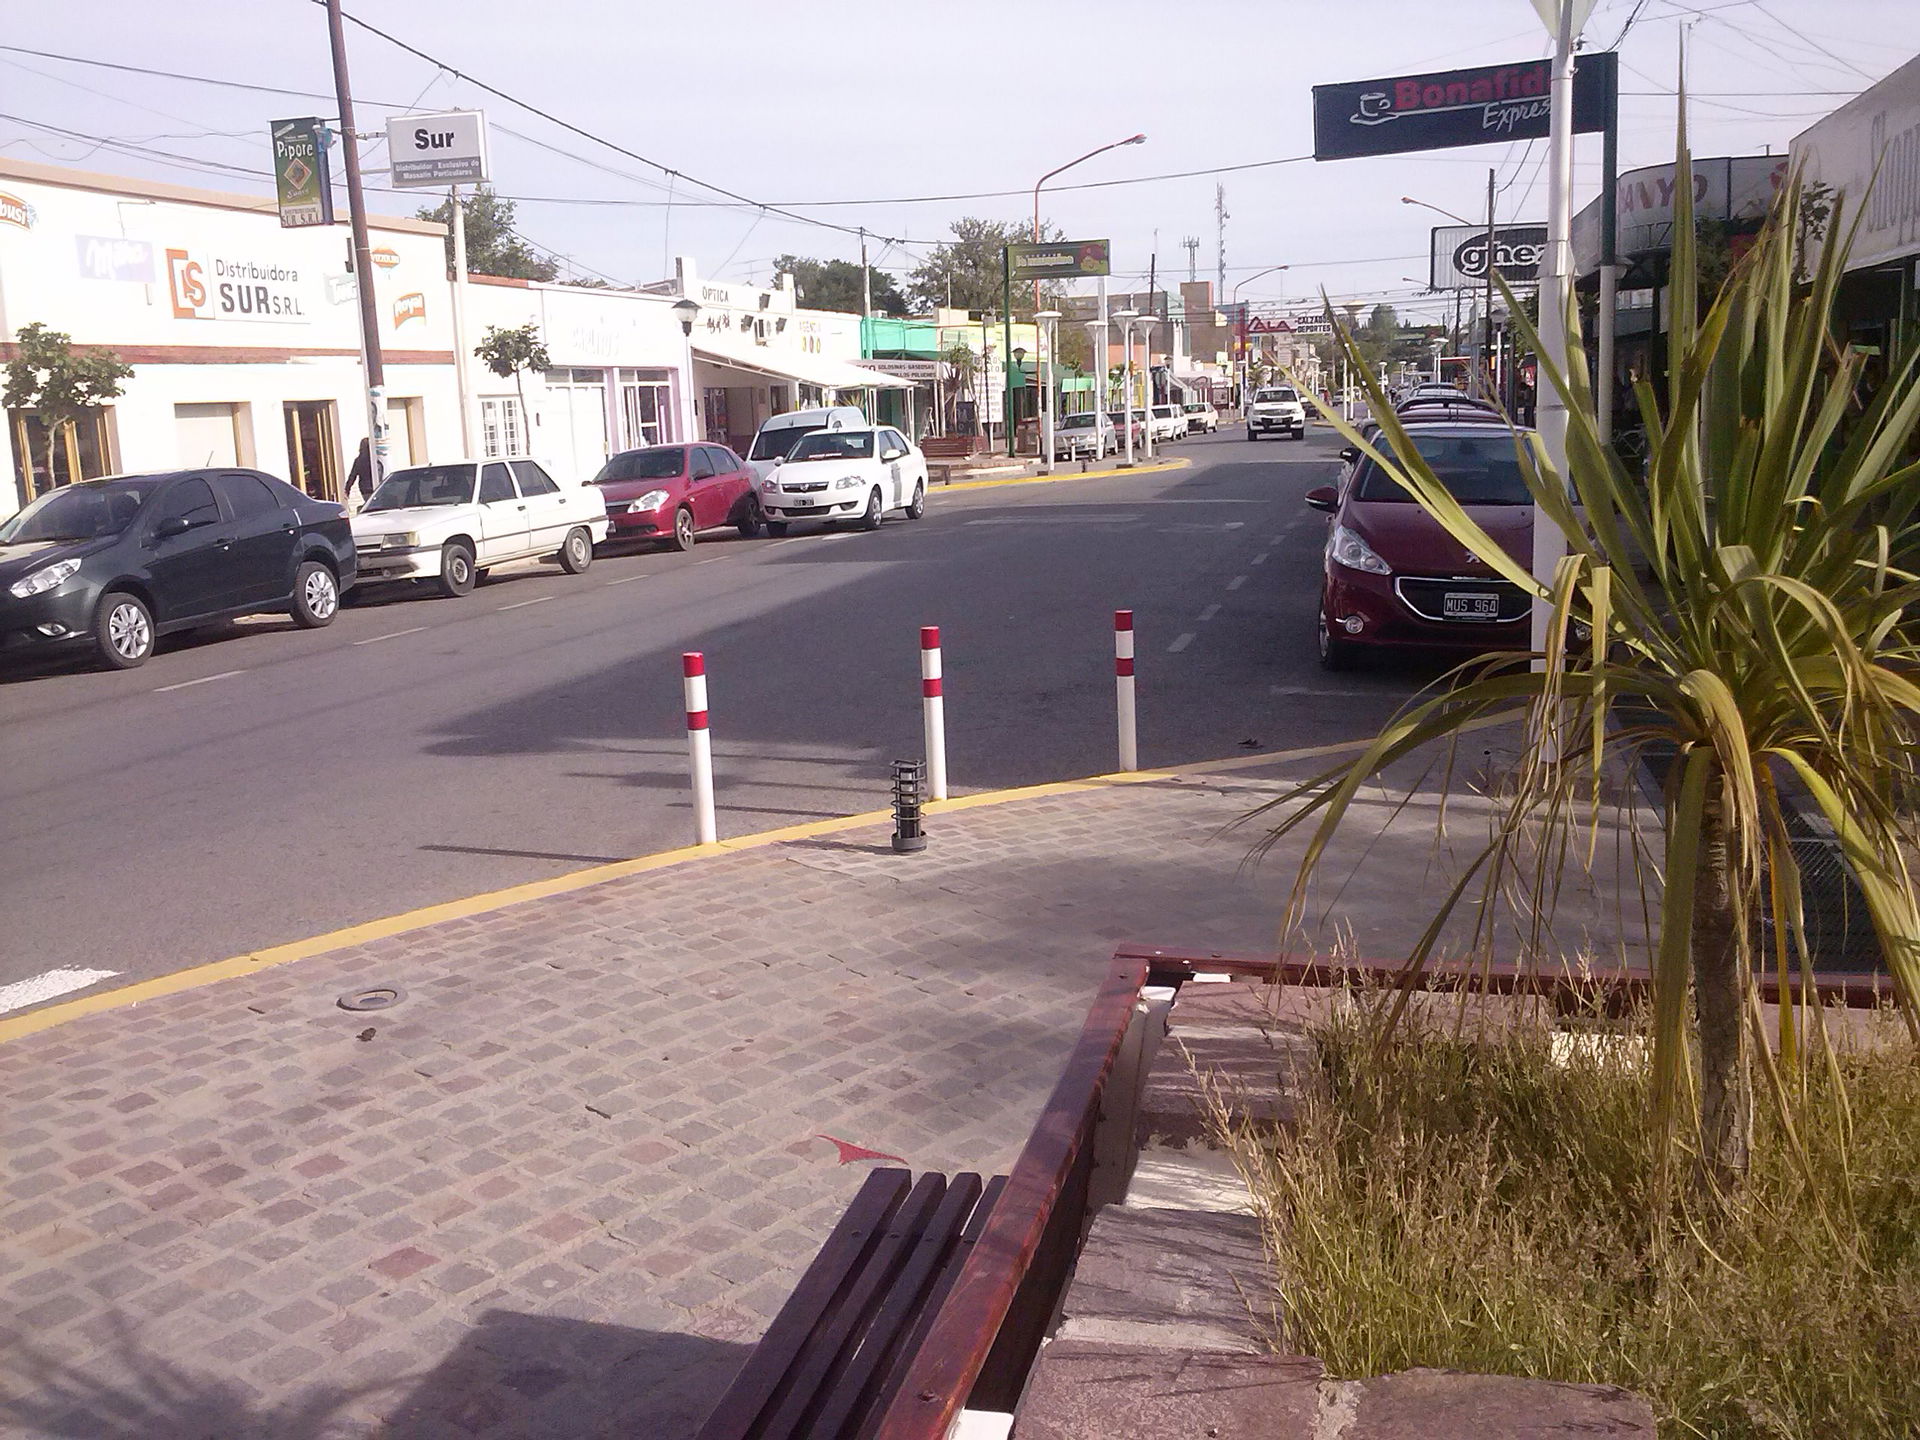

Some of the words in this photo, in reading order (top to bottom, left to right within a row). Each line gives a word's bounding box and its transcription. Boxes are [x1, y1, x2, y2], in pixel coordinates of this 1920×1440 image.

[1394, 65, 1551, 111] Bonafid
[1482, 100, 1551, 132] Expres
[414, 128, 455, 150] Sur
[216, 259, 299, 281] Distribuidora
[219, 283, 271, 314] SUR
[1297, 325, 1331, 333] DEPORTES
[1446, 599, 1468, 611] MUS
